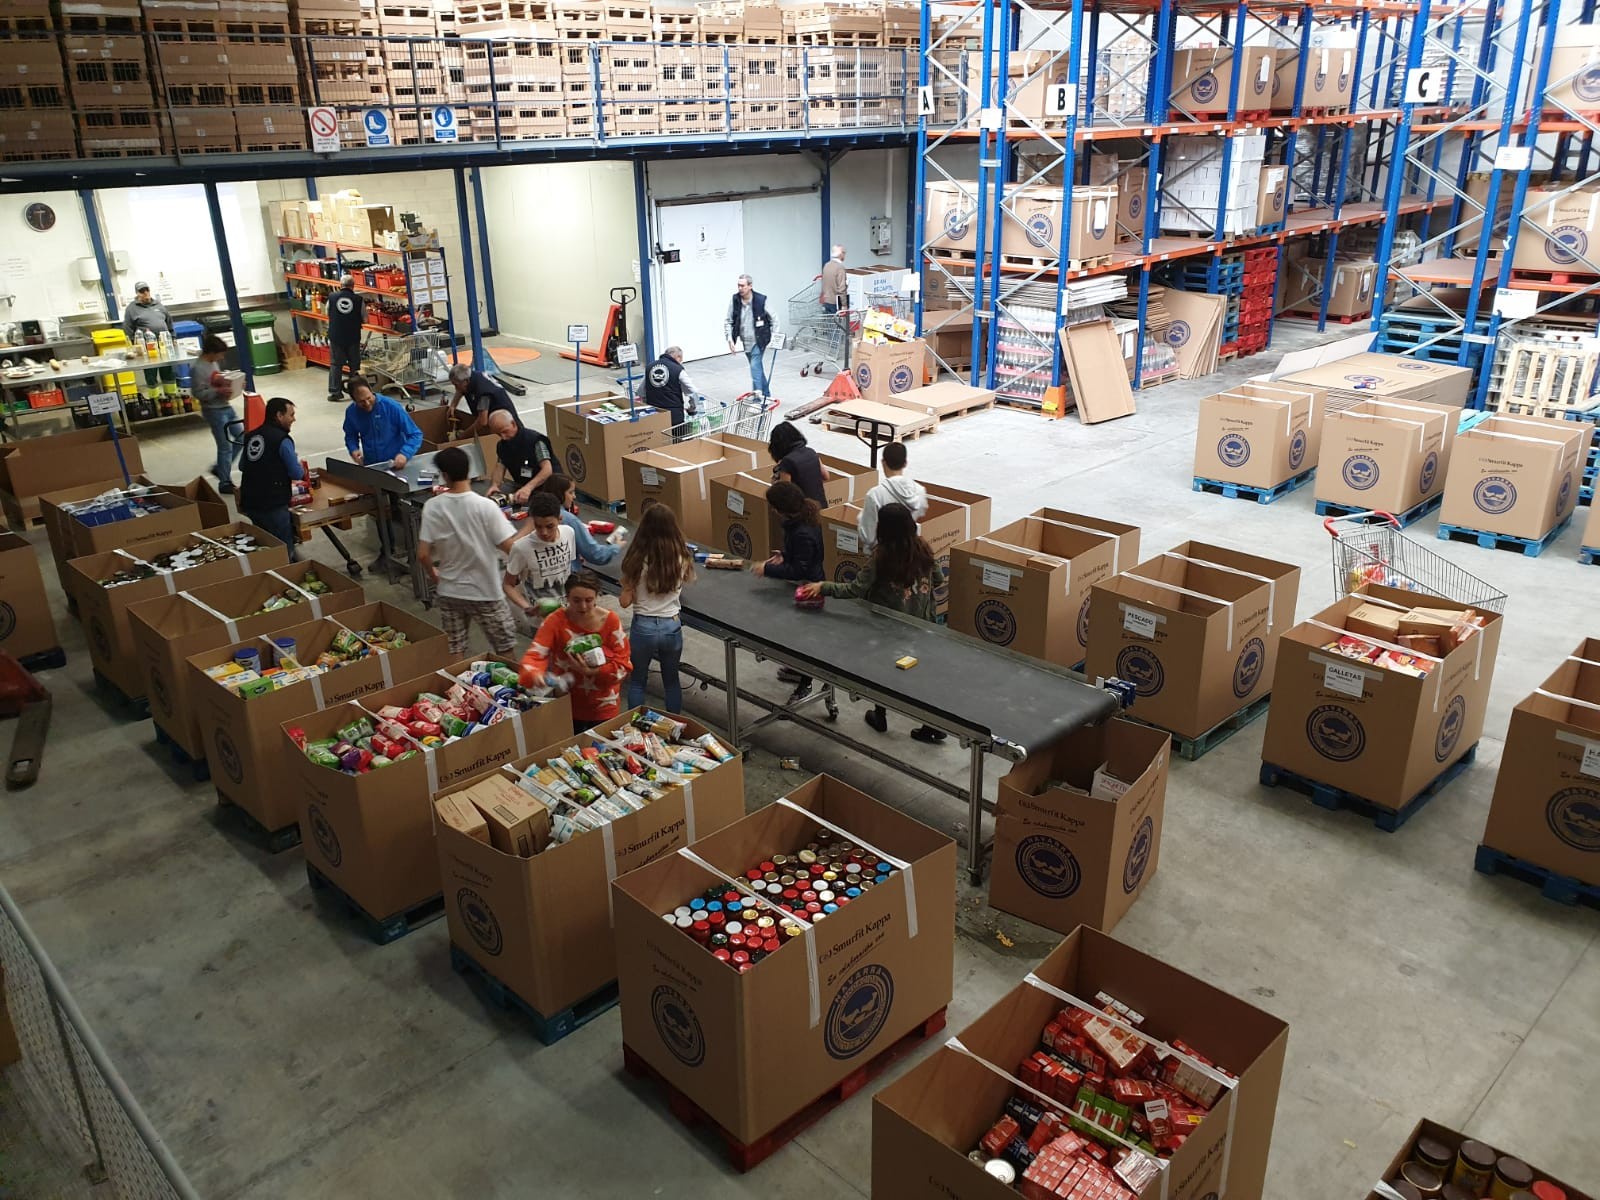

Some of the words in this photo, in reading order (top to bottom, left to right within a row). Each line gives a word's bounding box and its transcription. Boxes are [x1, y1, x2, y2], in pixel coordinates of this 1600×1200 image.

[1418, 71, 1430, 98] C
[922, 89, 930, 111] A
[1056, 87, 1066, 111] B
[1127, 611, 1154, 625] PESCADO
[1328, 666, 1362, 681] GALLETAS
[364, 680, 385, 692] Kapp
[454, 757, 485, 777] Smurfit
[486, 747, 512, 763] Kappa
[1059, 809, 1086, 828] Kappa
[627, 831, 660, 855] Smurfit
[660, 818, 686, 837] Kappa
[832, 926, 865, 956] Smurfit
[865, 911, 892, 935] Kappa
[834, 965, 883, 1004] NAVARRA
